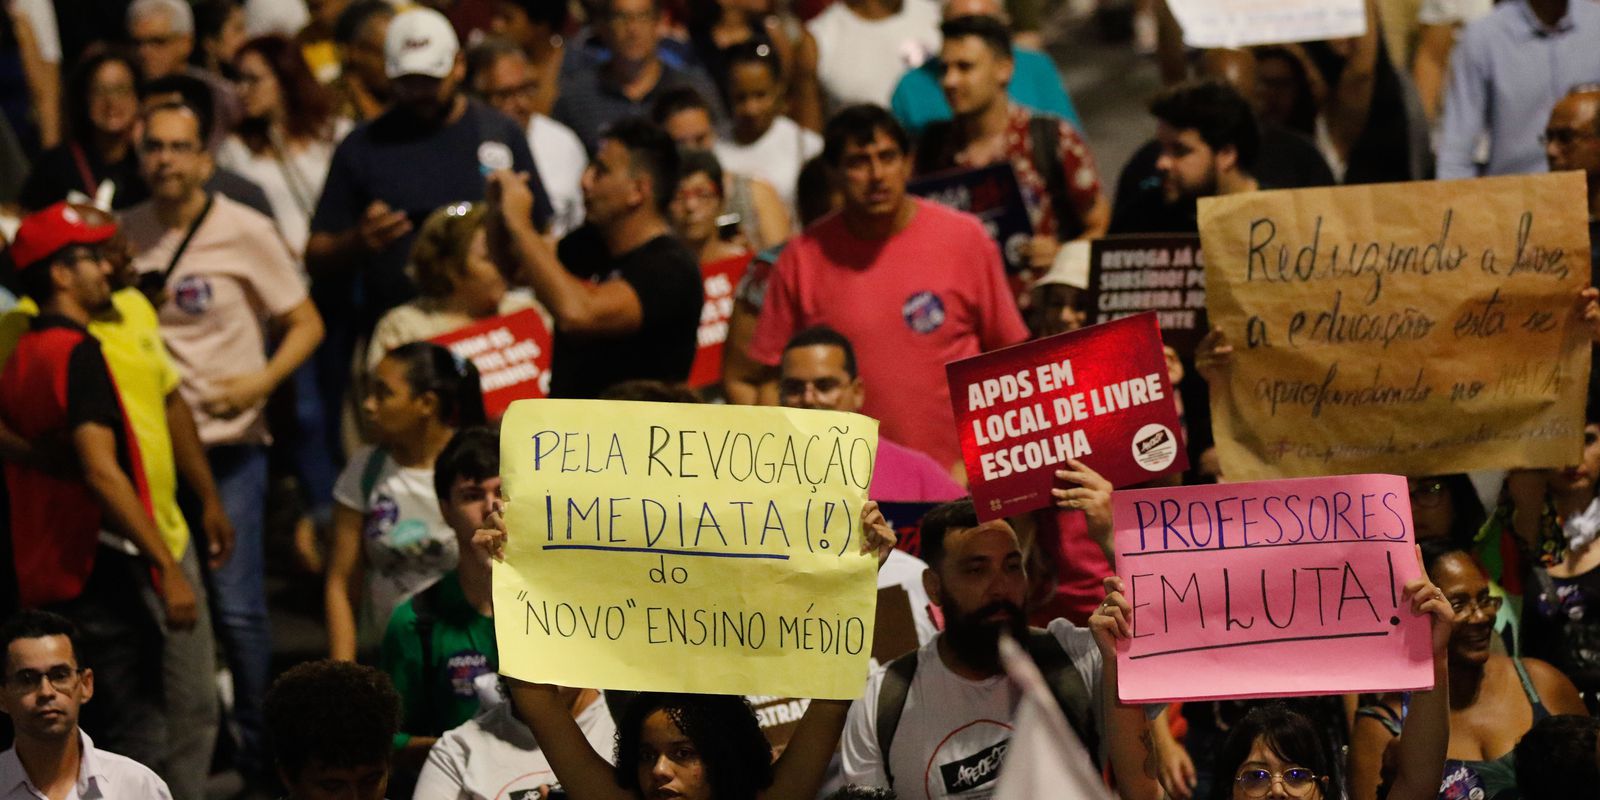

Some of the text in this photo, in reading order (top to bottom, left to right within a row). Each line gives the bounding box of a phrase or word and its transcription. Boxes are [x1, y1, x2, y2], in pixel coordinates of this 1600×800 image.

[1101, 248, 1169, 269] REVOGA
[1173, 245, 1193, 267] JÁ
[1480, 248, 1499, 274] a
[1098, 290, 1182, 311] CARREIRA
[1246, 315, 1272, 349] a
[968, 359, 1075, 411] APDS EM
[972, 373, 1164, 446] LOCAL DE LIVRE
[531, 425, 872, 494] PELA REVOGAÇÃO
[980, 429, 1092, 481] ESCOLHA
[545, 489, 791, 548] IMEDIATA
[804, 498, 852, 557] (!)
[1133, 491, 1406, 551] PROFESSORES
[649, 555, 688, 584] do
[1131, 550, 1401, 639] EM LUTA!
[517, 590, 865, 655] "NOVO" ENSINO MÉDIO
